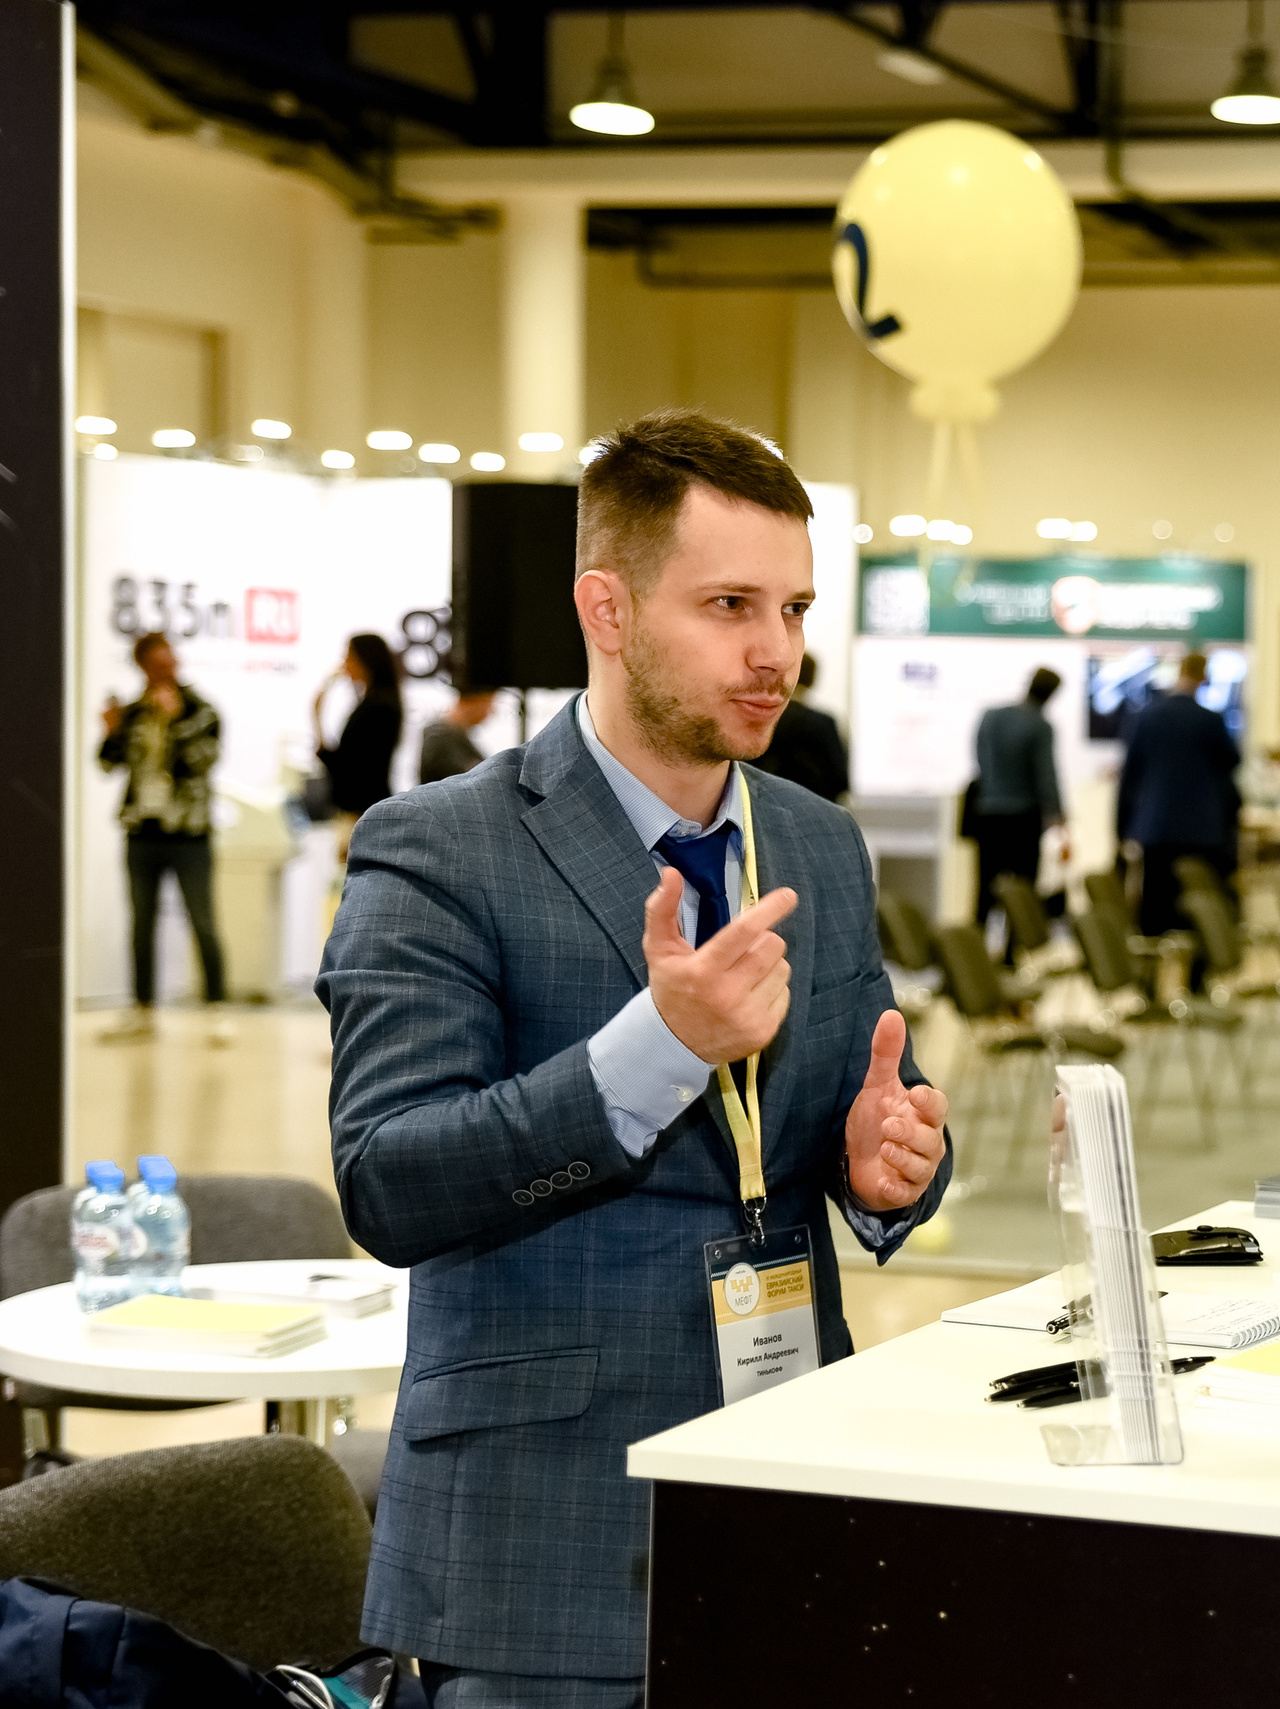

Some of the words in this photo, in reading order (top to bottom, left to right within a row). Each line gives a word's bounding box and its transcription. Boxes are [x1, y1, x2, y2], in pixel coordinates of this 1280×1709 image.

[767, 1288, 787, 1298] ФОРУМ
[788, 1285, 804, 1295] ТАКСИ
[735, 1295, 752, 1307] МЕФТ
[753, 1333, 782, 1347] Иванов
[737, 1354, 762, 1367] Кирилл
[763, 1347, 799, 1362] Андреевич
